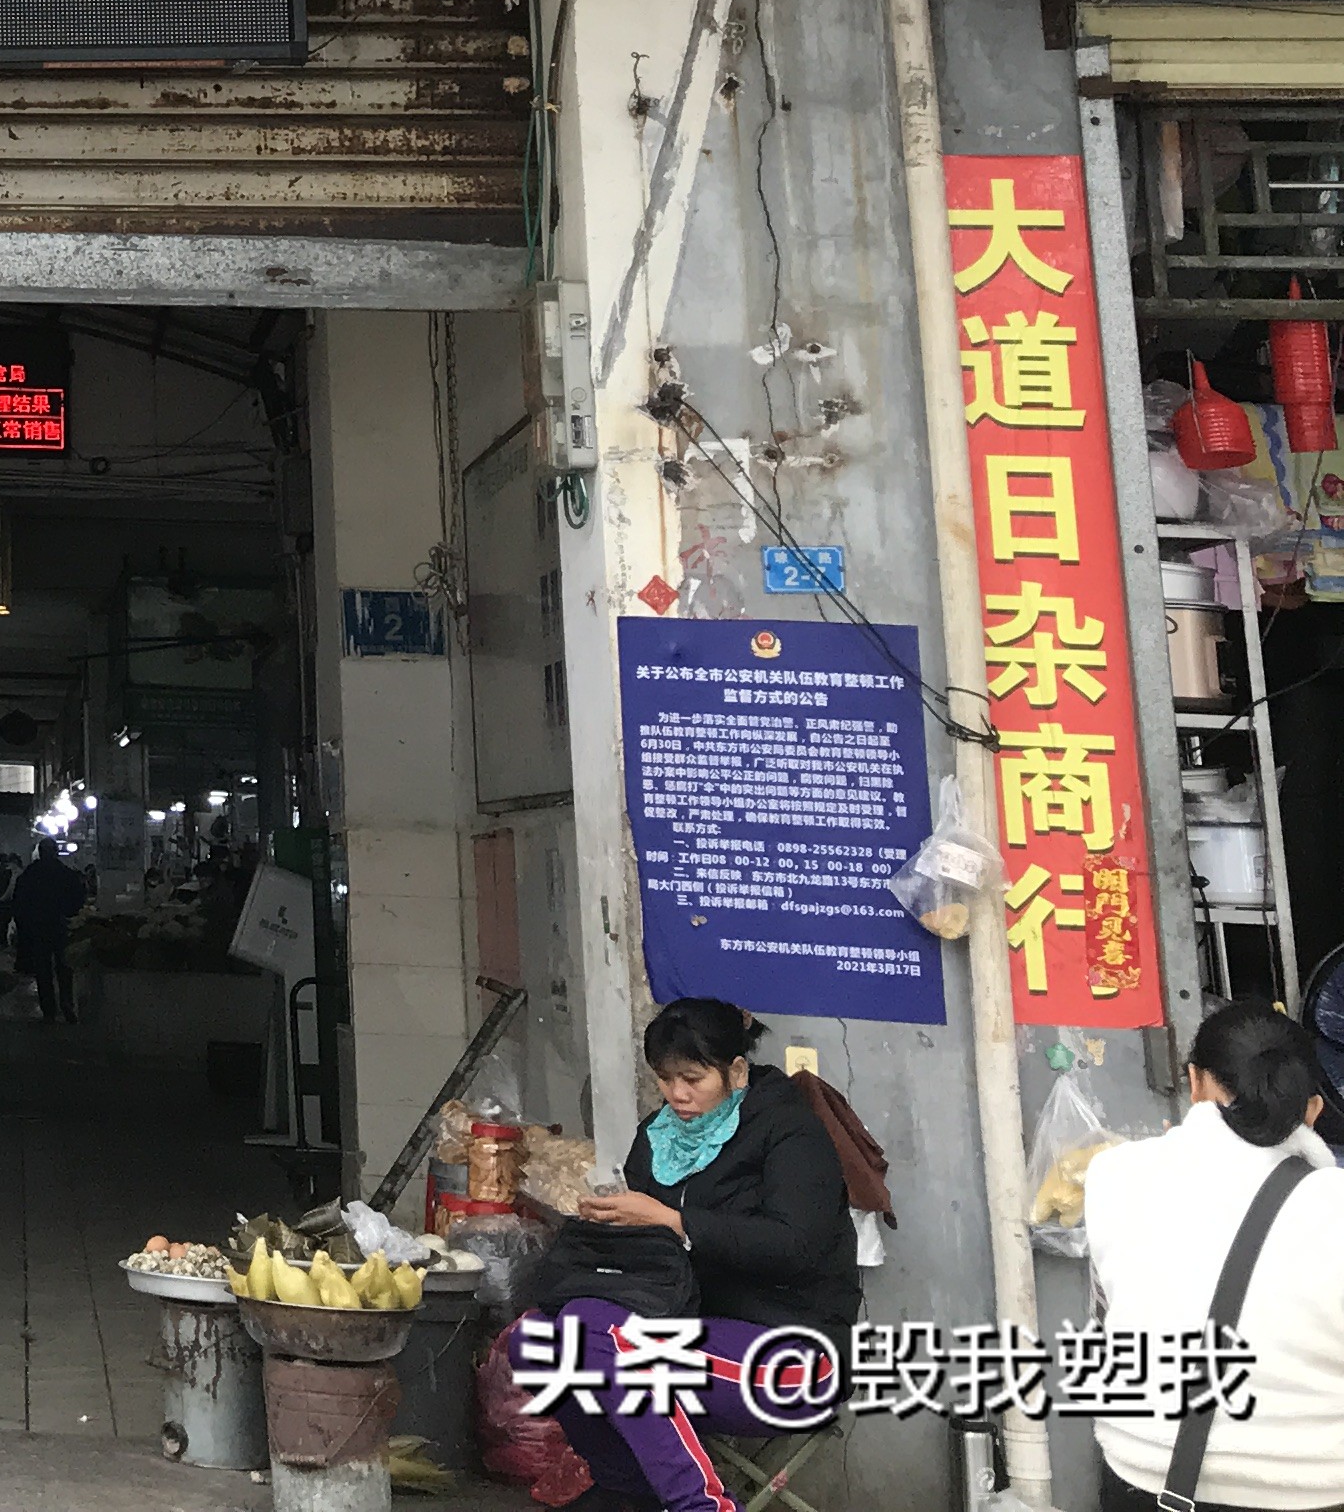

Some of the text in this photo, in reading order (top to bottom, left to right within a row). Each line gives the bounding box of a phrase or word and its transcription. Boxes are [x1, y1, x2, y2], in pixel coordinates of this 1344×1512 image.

[946, 177, 1119, 997] 大道日杂商行
[635, 664, 905, 691] 关于公布全市公安机关队伍教育整顿工作
[723, 687, 829, 707] 监督方式的公告
[720, 938, 921, 963] 东方市公安机关队伍教育整顿领导小组
[836, 960, 921, 977] 2021年3月17日
